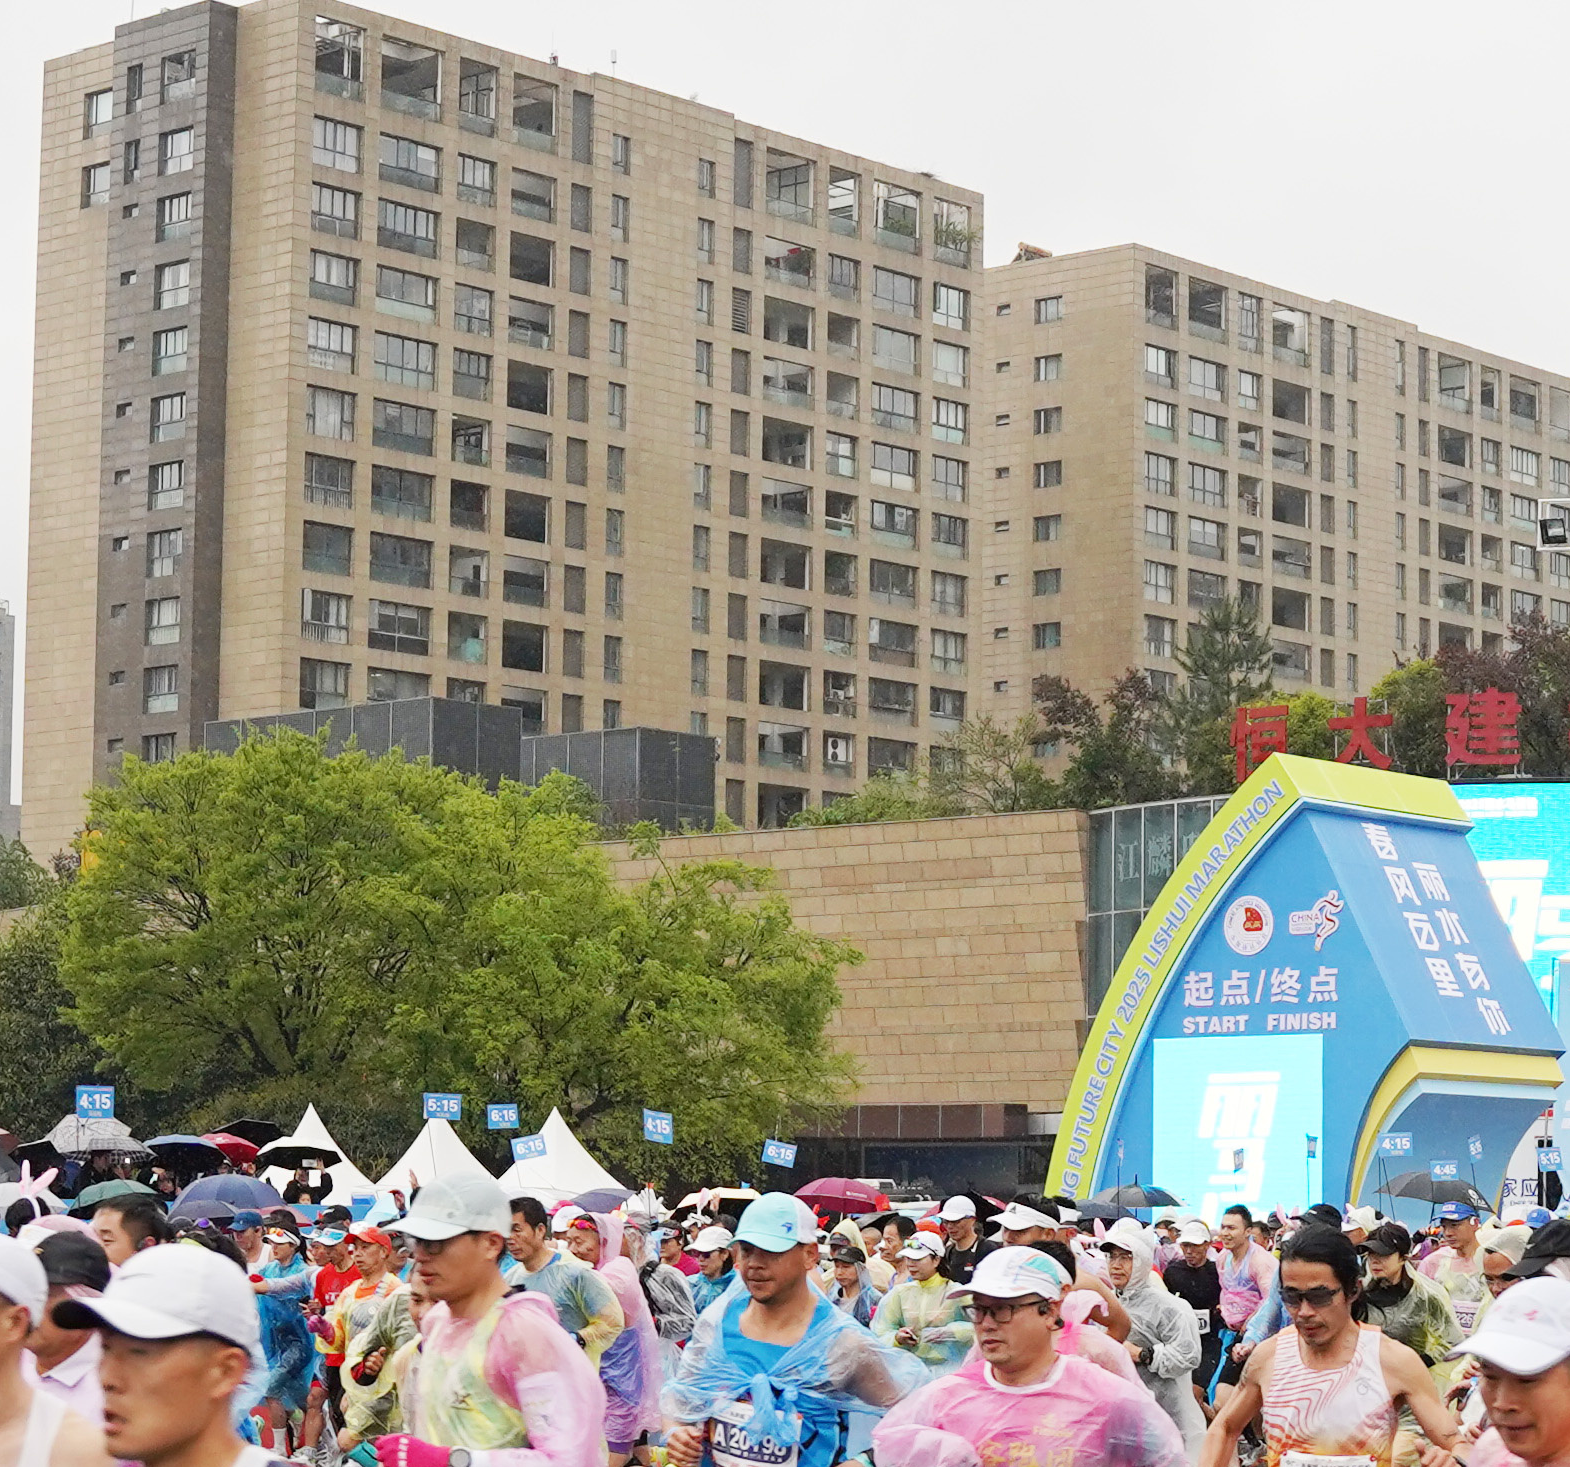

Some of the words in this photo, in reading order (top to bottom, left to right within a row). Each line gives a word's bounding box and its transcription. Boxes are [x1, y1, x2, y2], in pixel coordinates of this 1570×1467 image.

[1291, 913, 1320, 923] CHINA
[1069, 1074, 1107, 1172] FUTURE
[1095, 1021, 1126, 1079] CITY
[1116, 966, 1153, 1024] 2025
[1141, 898, 1193, 970] LISHUI
[1184, 779, 1287, 904] MARATHON
[1183, 965, 1340, 1008] 起点/终点
[1182, 1014, 1250, 1034] START
[1266, 1011, 1338, 1032] FINISH
[79, 1092, 112, 1111] 4:15
[427, 1098, 459, 1113] 5:15
[490, 1109, 517, 1122] 6:15
[644, 1119, 671, 1135] 4:15
[516, 1138, 545, 1154] 6:15
[1196, 1070, 1282, 1222] 丽马
[1381, 1137, 1411, 1151] 4:15
[766, 1144, 794, 1161] 6:15
[1539, 1152, 1561, 1166] 5:15
[1433, 1164, 1457, 1176] 4:45
[729, 1427, 787, 1457] 209
